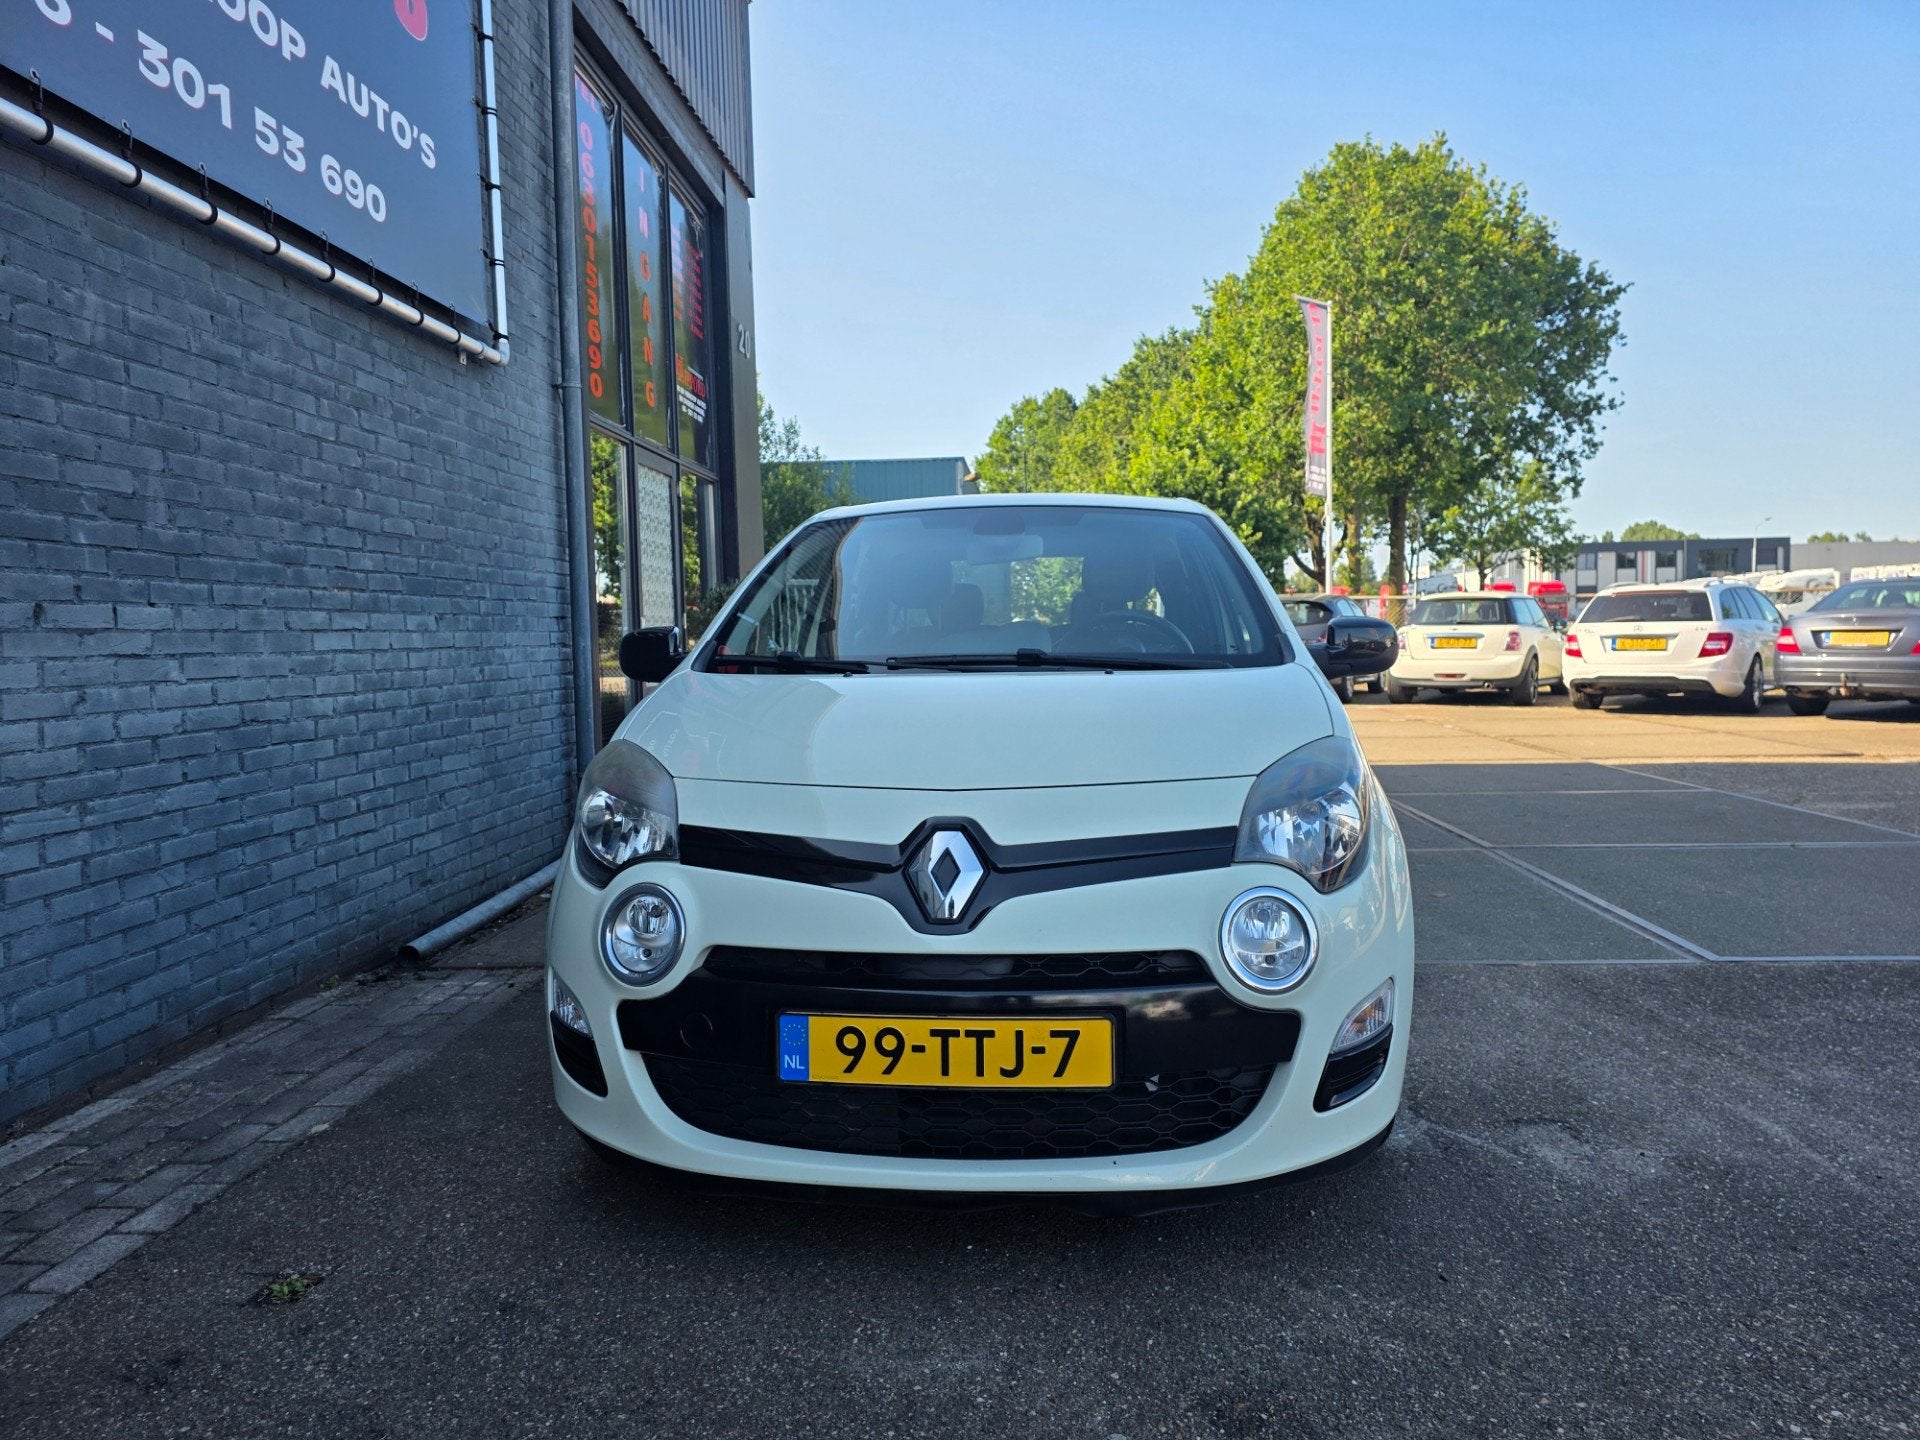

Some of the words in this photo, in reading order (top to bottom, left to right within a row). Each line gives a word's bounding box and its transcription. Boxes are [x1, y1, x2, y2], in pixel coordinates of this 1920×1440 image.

[137, 29, 232, 130] 301
[254, 105, 306, 173] 53
[320, 153, 387, 223] 690
[320, 54, 436, 169] AUTO'S
[738, 323, 751, 359] 20
[784, 1054, 805, 1069] NL
[835, 1025, 1081, 1078] 99-TTJ-7
